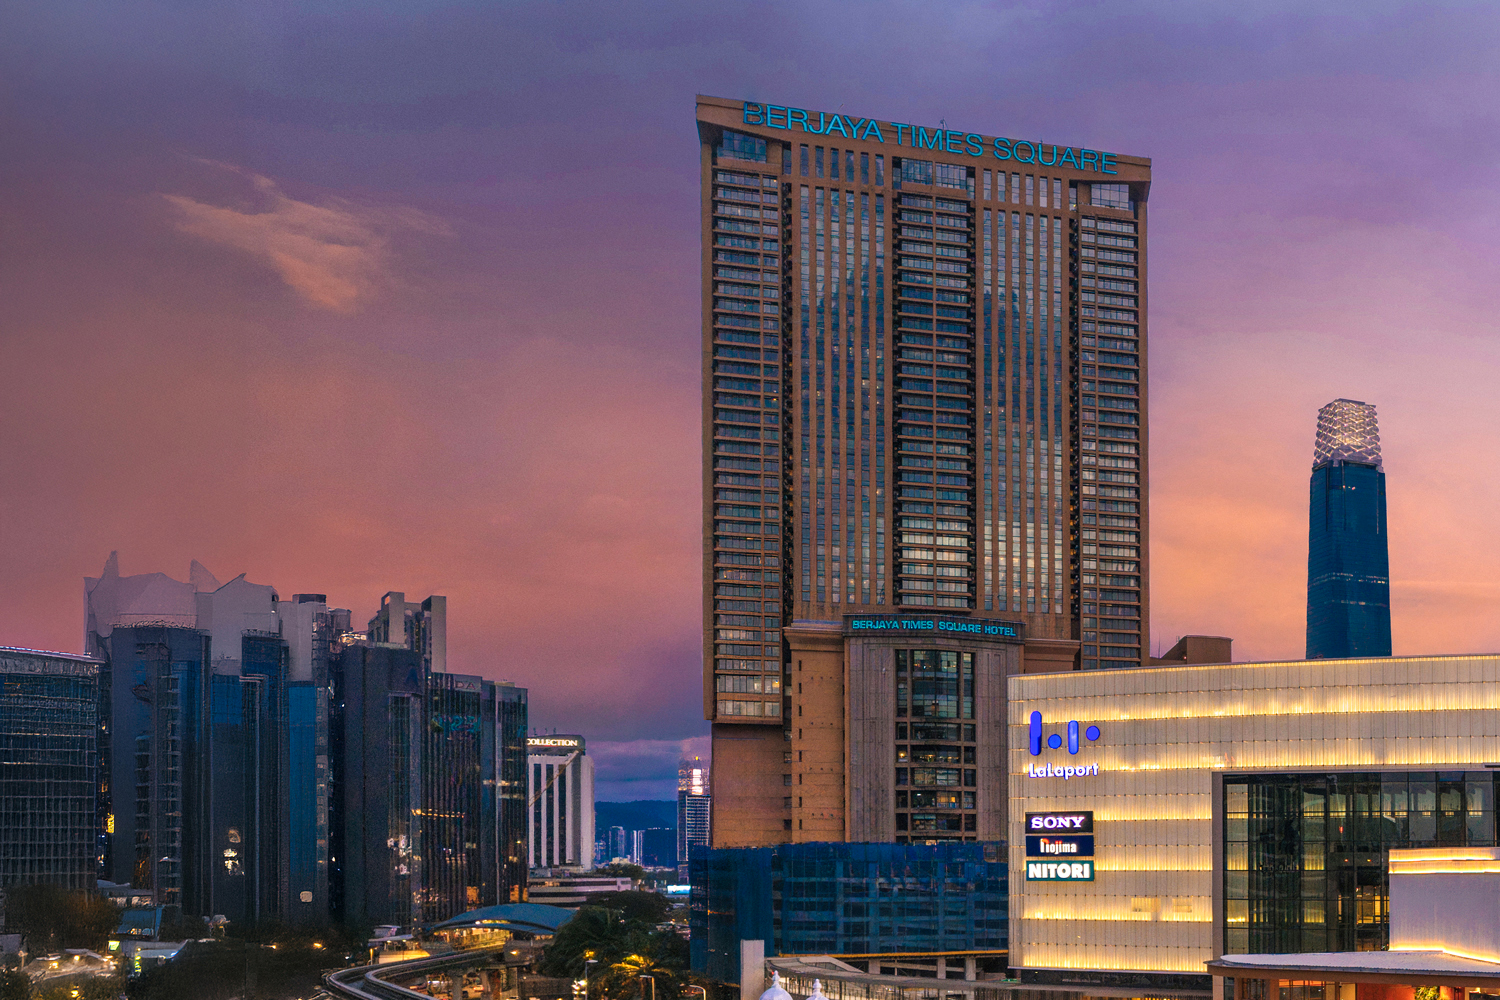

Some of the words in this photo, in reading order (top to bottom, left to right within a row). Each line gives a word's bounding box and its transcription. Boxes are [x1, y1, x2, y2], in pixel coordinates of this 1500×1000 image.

[742, 101, 885, 143] BERJAYA
[889, 121, 984, 157] TIMES
[993, 137, 1118, 175] SQUARE
[852, 620, 899, 630] BERJAYA
[901, 620, 934, 630] TIMES
[938, 622, 982, 634] SQUARE
[984, 626, 1017, 637] HOTEL
[1028, 762, 1099, 780] LaLaport
[1031, 816, 1085, 829] SONY
[1040, 838, 1077, 855] nojima
[1028, 863, 1091, 879] NITORI
